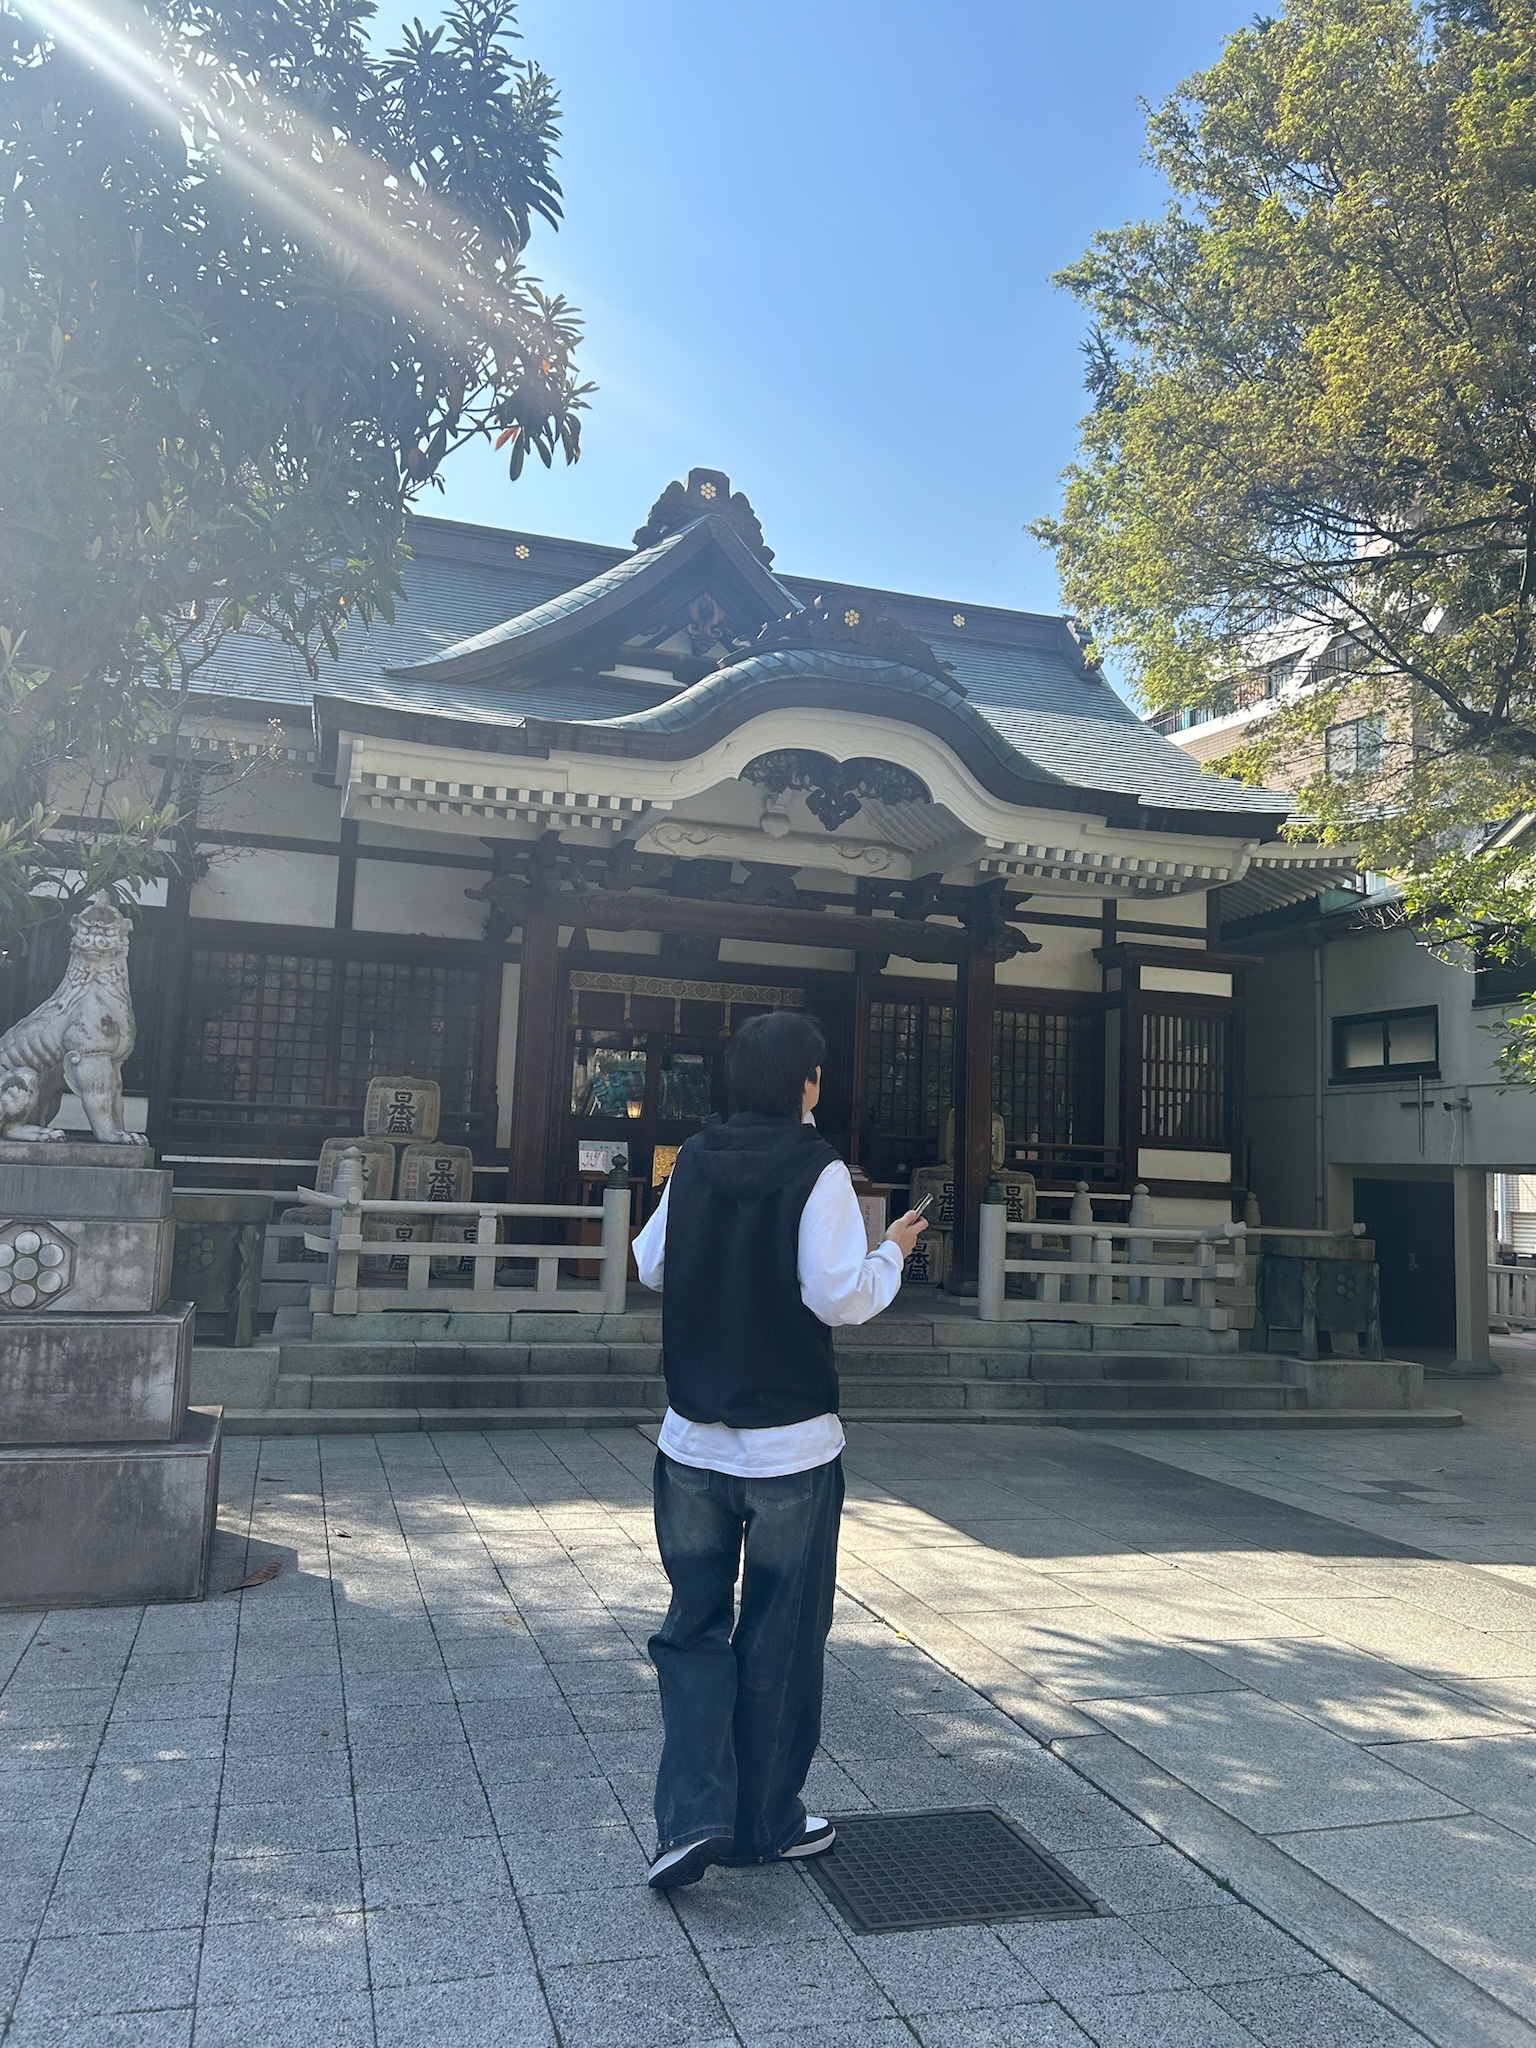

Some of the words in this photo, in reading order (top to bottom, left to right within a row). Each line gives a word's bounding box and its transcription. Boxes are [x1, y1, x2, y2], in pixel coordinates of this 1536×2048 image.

[386, 1091, 416, 1135] 日本盛
[427, 1159, 455, 1202] 日本盛
